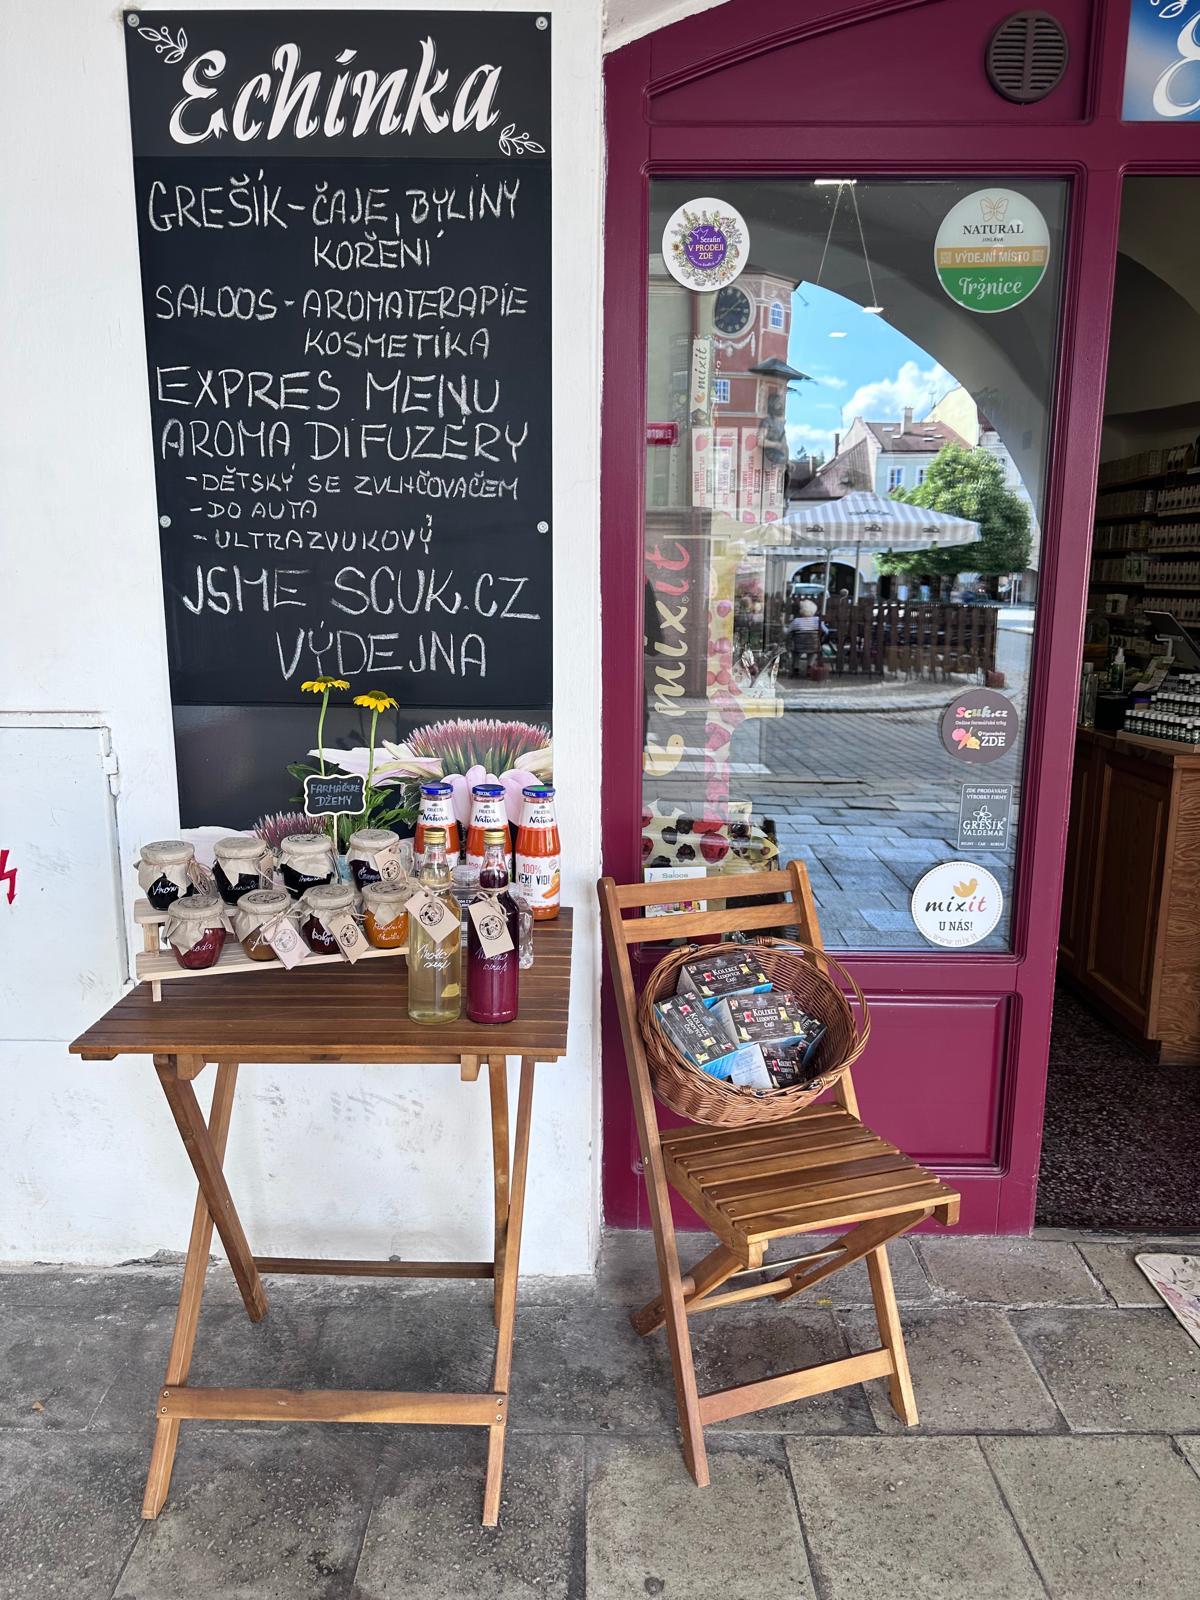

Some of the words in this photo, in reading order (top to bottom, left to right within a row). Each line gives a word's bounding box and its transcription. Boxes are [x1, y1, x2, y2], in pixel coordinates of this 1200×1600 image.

[169, 36, 502, 145] Echinka
[406, 174, 520, 223] BYLINY
[963, 223, 1024, 235] NATURAL
[313, 230, 444, 270] KOŘENÍ
[687, 244, 693, 252] V
[695, 243, 724, 252] PRODEJI
[698, 252, 713, 260] ZDE
[955, 249, 997, 263] VÝDEJNÍ
[999, 248, 1030, 262] MÍSTO
[958, 276, 1022, 300] Tržnice
[155, 284, 278, 321] SALOOS
[302, 282, 529, 321] AROMATERAPIE
[304, 326, 490, 359] KOSMETIKA
[156, 366, 341, 411] EXPRES
[365, 369, 500, 418] MENU
[162, 418, 292, 460] AROMA
[308, 474, 341, 494] SE
[251, 499, 318, 519] AUTA
[181, 565, 311, 615] JSME
[275, 621, 487, 681] VÝDEJNA
[981, 736, 1006, 747] ZDE
[315, 794, 352, 807] DŽEMY
[422, 813, 449, 822] Natura
[474, 815, 501, 824] Natura
[529, 816, 554, 824] Natura
[522, 863, 542, 874] 100%
[925, 895, 987, 912] mixit
[938, 921, 946, 931] U
[949, 918, 973, 931] NÁS!
